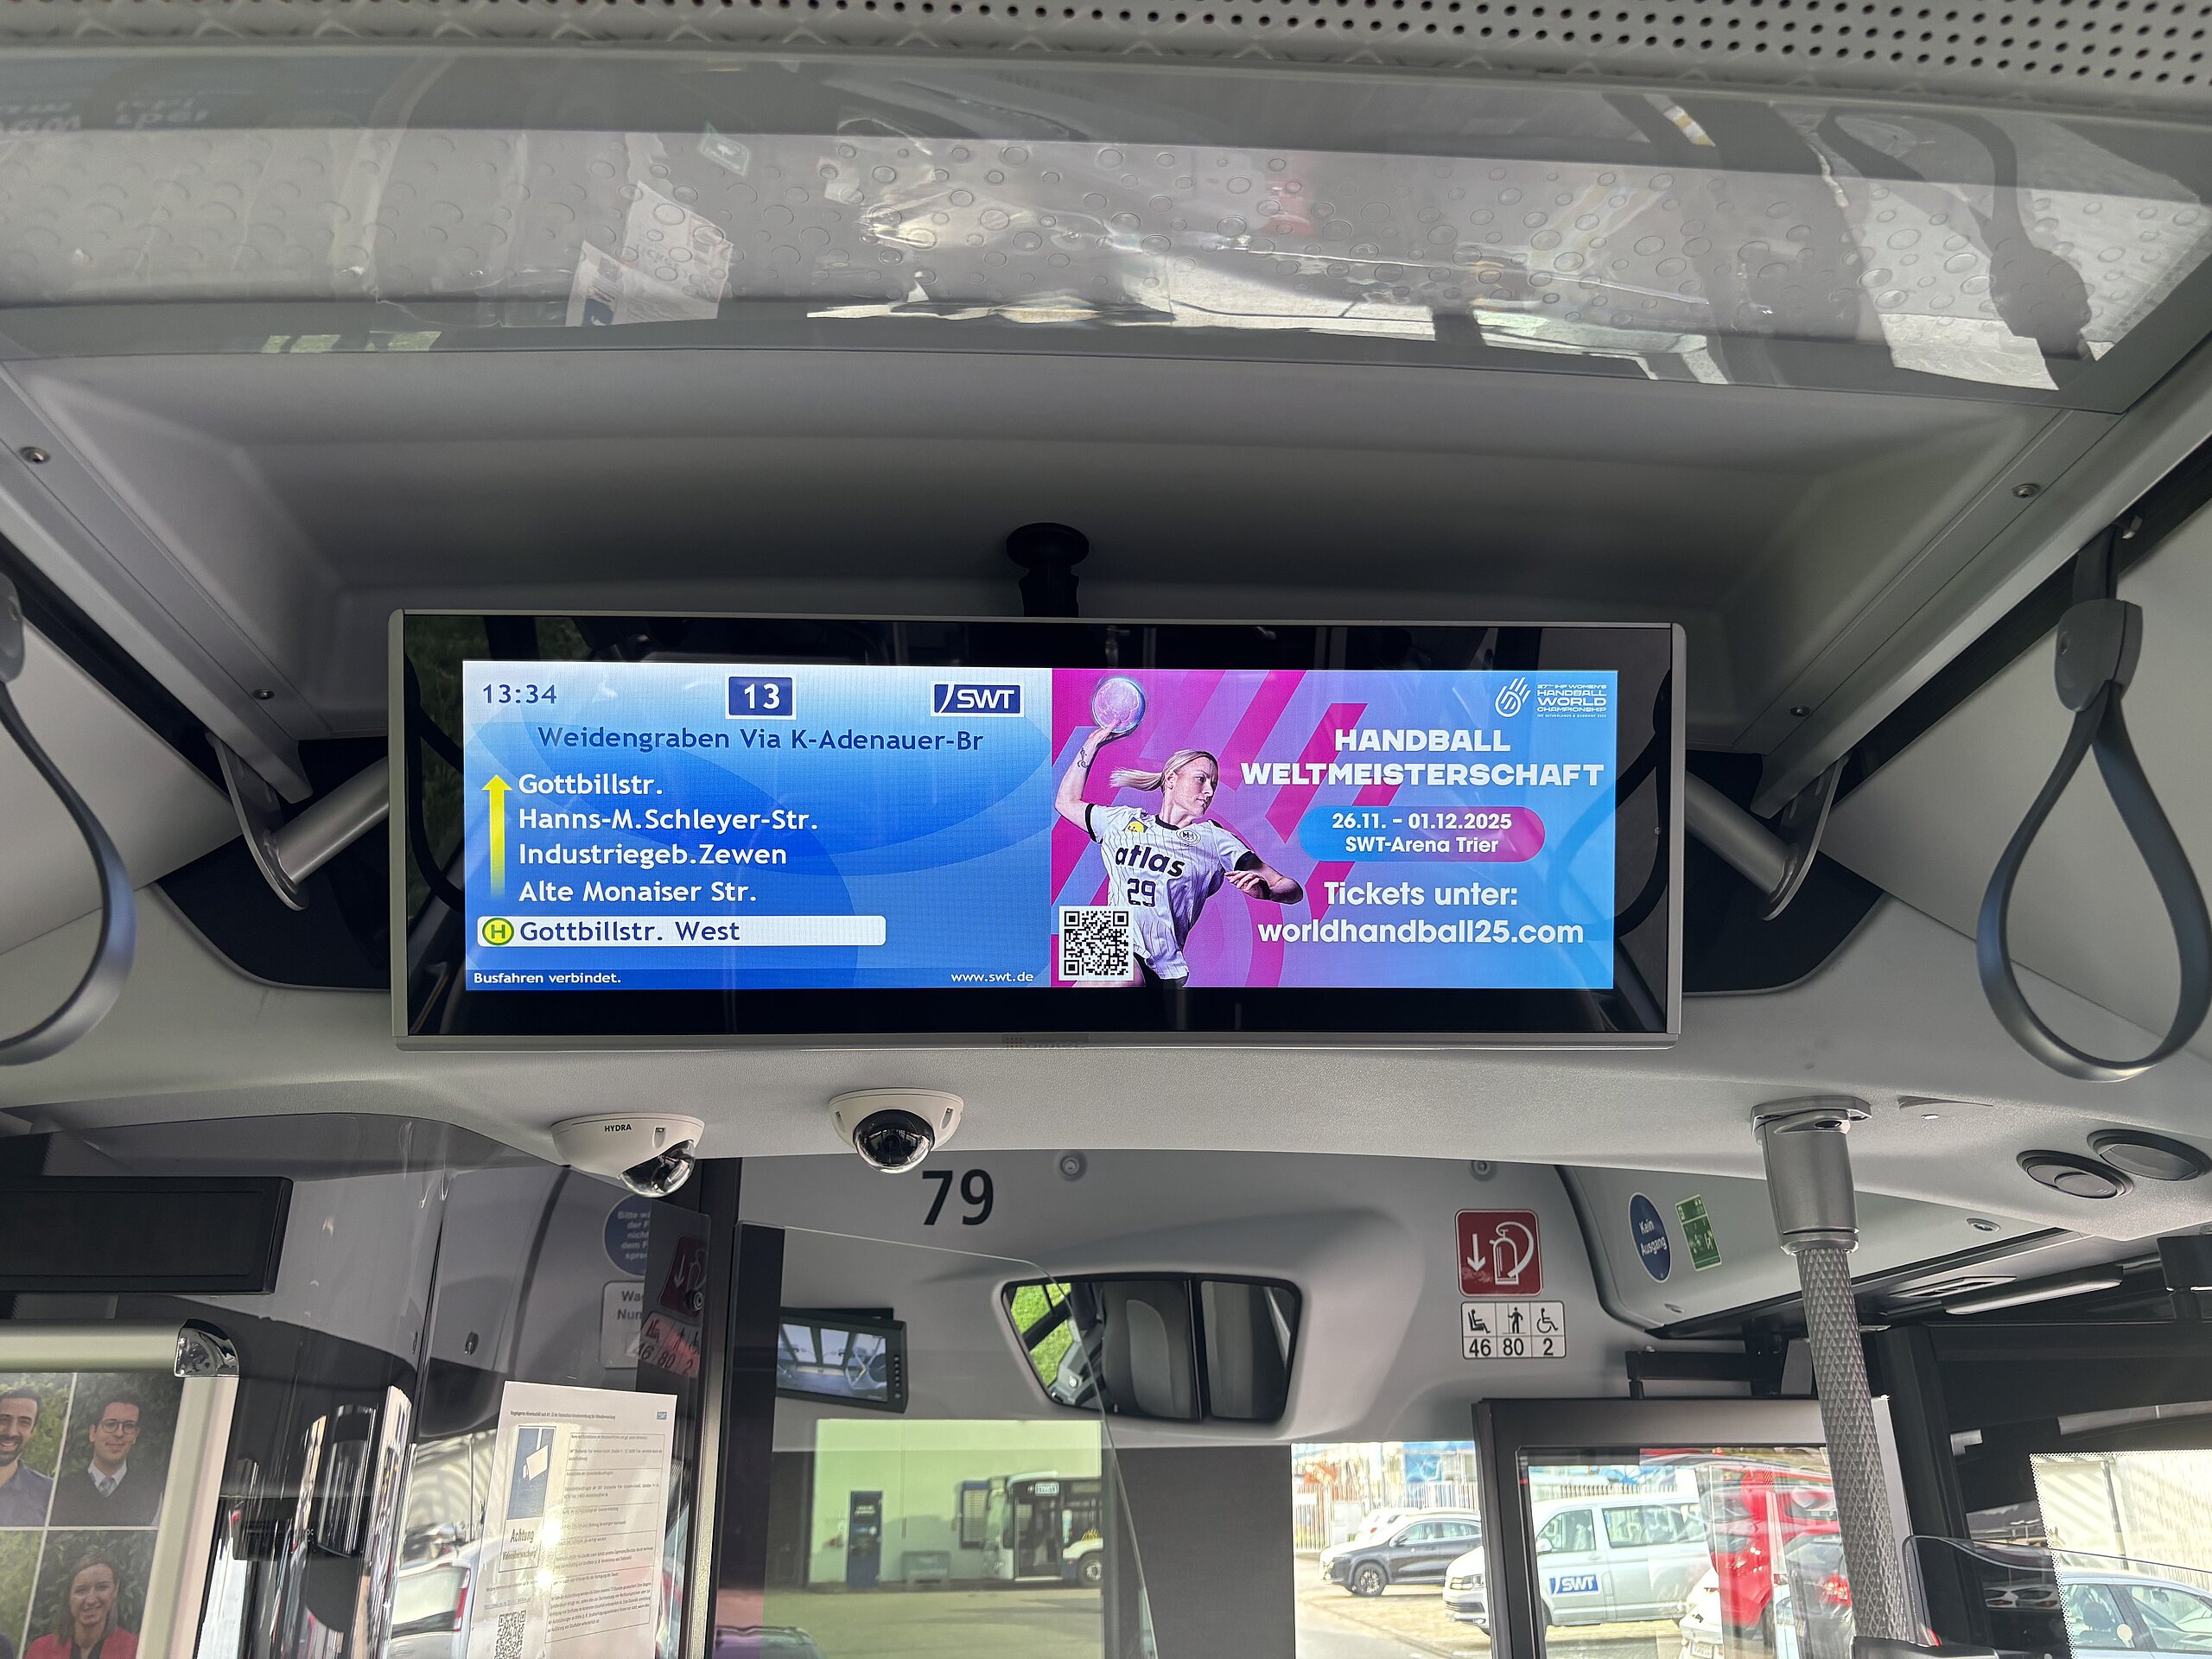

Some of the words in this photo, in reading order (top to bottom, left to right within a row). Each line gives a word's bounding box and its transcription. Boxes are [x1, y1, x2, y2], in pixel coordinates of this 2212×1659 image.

[483, 683, 557, 704] 13:34
[743, 683, 781, 709] 13
[956, 688, 1016, 709] SWT
[1536, 696, 1607, 707] WORLD
[537, 727, 729, 753] Weidengraben
[739, 728, 782, 749] Via
[791, 729, 984, 751] K-Adenauer-Br
[1334, 728, 1511, 753] HANDBALL
[518, 773, 664, 795] Gottbillstr.
[1240, 761, 1605, 787] WELTMEISTERSCHAFT
[518, 807, 818, 835] Hanns-M.Schleyer-Str.
[1332, 812, 1387, 830] 26.11.
[1408, 812, 1513, 830] 01.12.2025
[1344, 836, 1451, 854] SWT-Arena
[1456, 836, 1499, 854] Trier
[518, 842, 787, 870] Industriegeb.Zewen
[1115, 844, 1185, 877] atlas
[518, 880, 574, 903] Alte
[582, 880, 702, 903] Monaiser
[710, 880, 757, 903] Str.
[1127, 878, 1157, 907] 29
[1323, 880, 1425, 906] Tickets
[1433, 881, 1518, 906] unter:
[519, 920, 664, 942] Gottbillstr.
[675, 921, 741, 942] West
[1256, 918, 1585, 944] worldhandball25.com
[474, 971, 544, 984] Busfahren
[548, 971, 622, 984] verbindet.
[950, 971, 1034, 982] www.swt.de
[604, 1123, 632, 1132] HYDRA
[922, 1168, 994, 1226] 79
[618, 1211, 639, 1219] Bitte
[1638, 1218, 1655, 1236] Kein
[621, 1241, 641, 1249] dem
[1640, 1236, 1668, 1256] Ausgang
[622, 1291, 643, 1301] Wa
[1469, 1338, 1491, 1357] 46
[1503, 1338, 1524, 1357] 80
[1542, 1337, 1554, 1357] 2
[509, 1528, 535, 1544] Achtung
[1560, 1575, 1595, 1592] SWT
